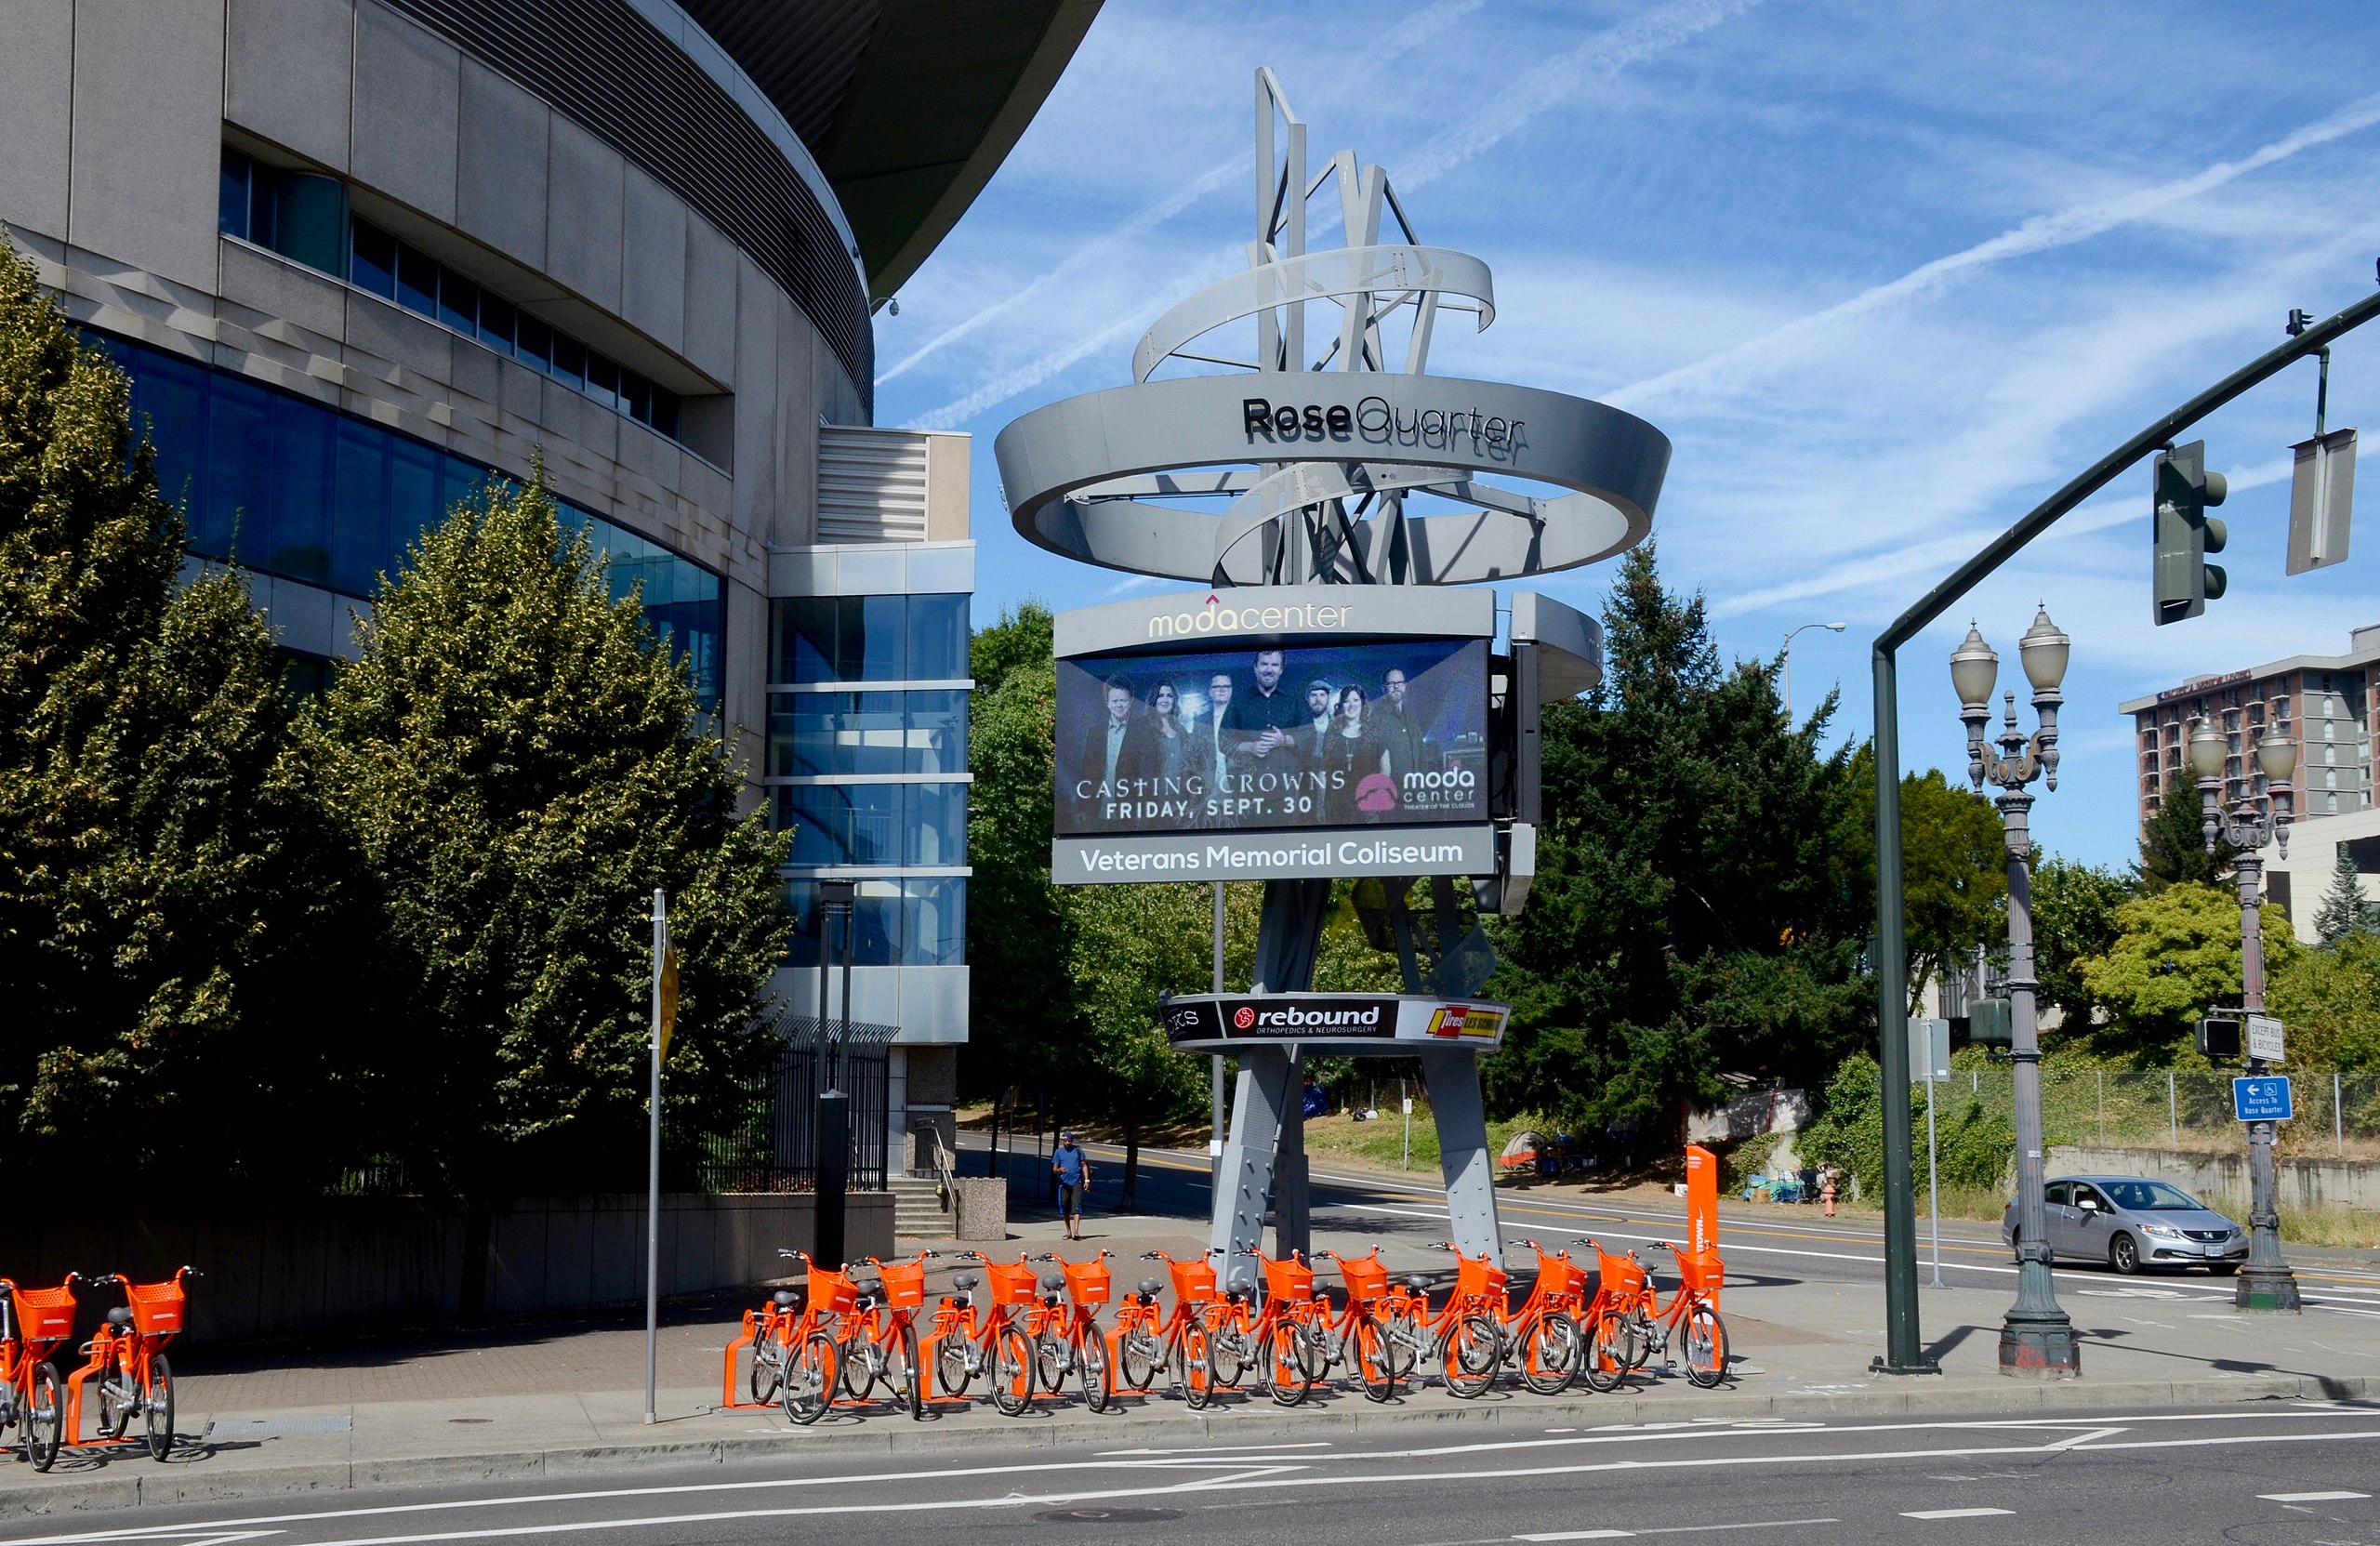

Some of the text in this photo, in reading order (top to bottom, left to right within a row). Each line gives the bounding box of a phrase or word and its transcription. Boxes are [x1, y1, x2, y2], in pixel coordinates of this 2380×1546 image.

[1077, 770, 1346, 799] CASTING CROWNS
[1403, 766, 1475, 789] moda
[1403, 789, 1474, 802] center
[1106, 796, 1312, 820] FRIDAY, SEPT. 30
[1080, 840, 1463, 872] Veterans Memorial Coliseum
[1258, 1007, 1380, 1025] rebound
[1440, 1010, 1464, 1029] Tires
[1463, 1016, 1477, 1029] LES
[2252, 1024, 2281, 1038] EXCEPT BUS
[2253, 1038, 2281, 1052] & BICYCLES
[2244, 1106, 2259, 1115] Rose
